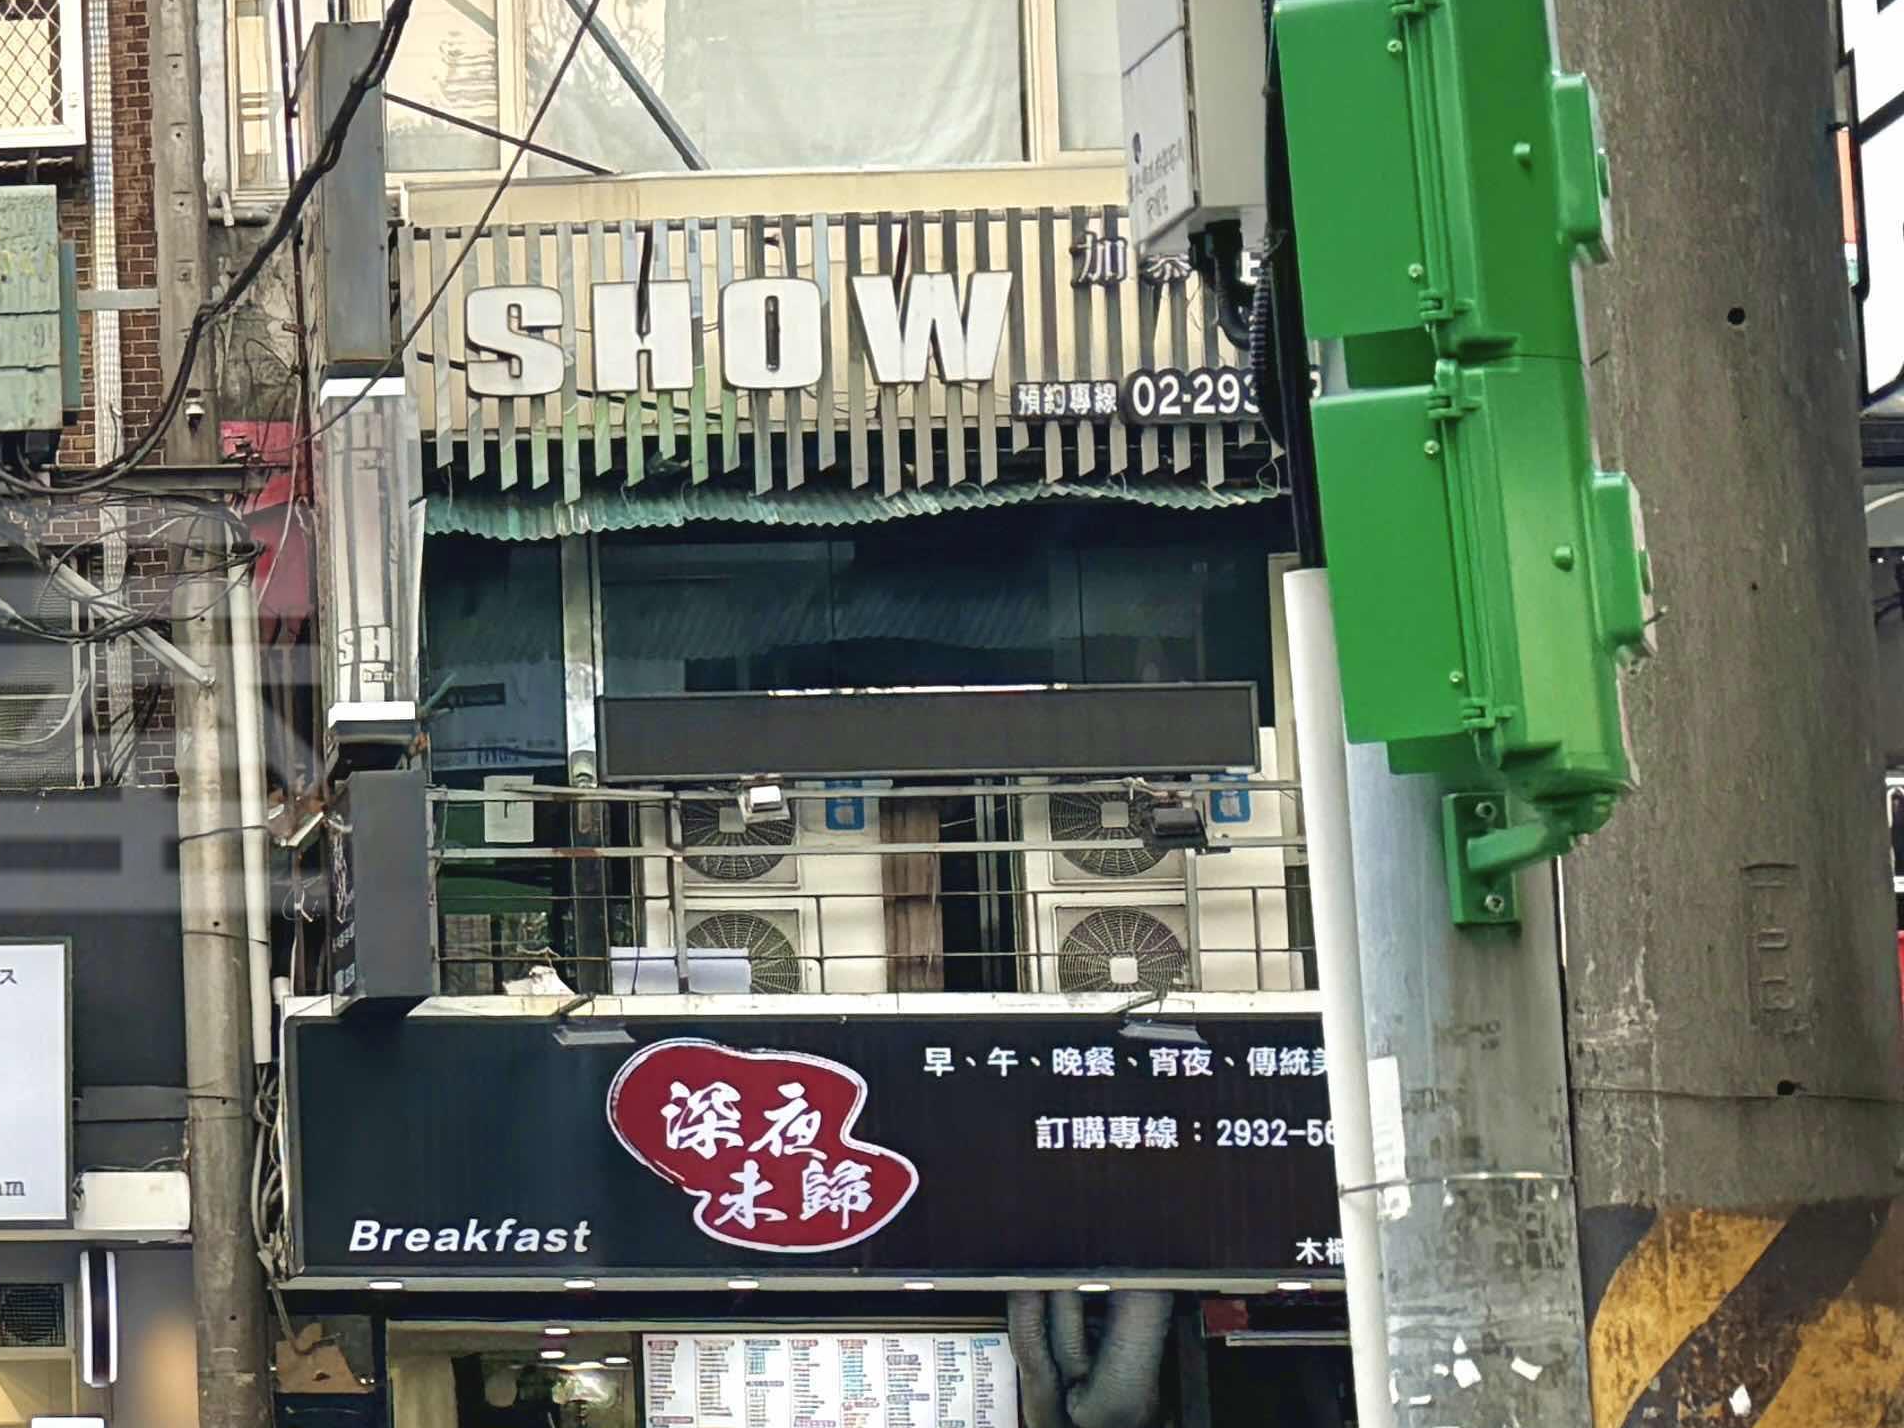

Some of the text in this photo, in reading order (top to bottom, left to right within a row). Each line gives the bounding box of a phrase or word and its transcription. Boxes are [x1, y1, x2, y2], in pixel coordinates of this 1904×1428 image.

[465, 270, 1013, 398] SHOW
[1018, 384, 1118, 416] 預約專線
[660, 1080, 827, 1162] 深夜
[714, 1160, 874, 1230] 未歸
[348, 1217, 594, 1257] Breakfast
